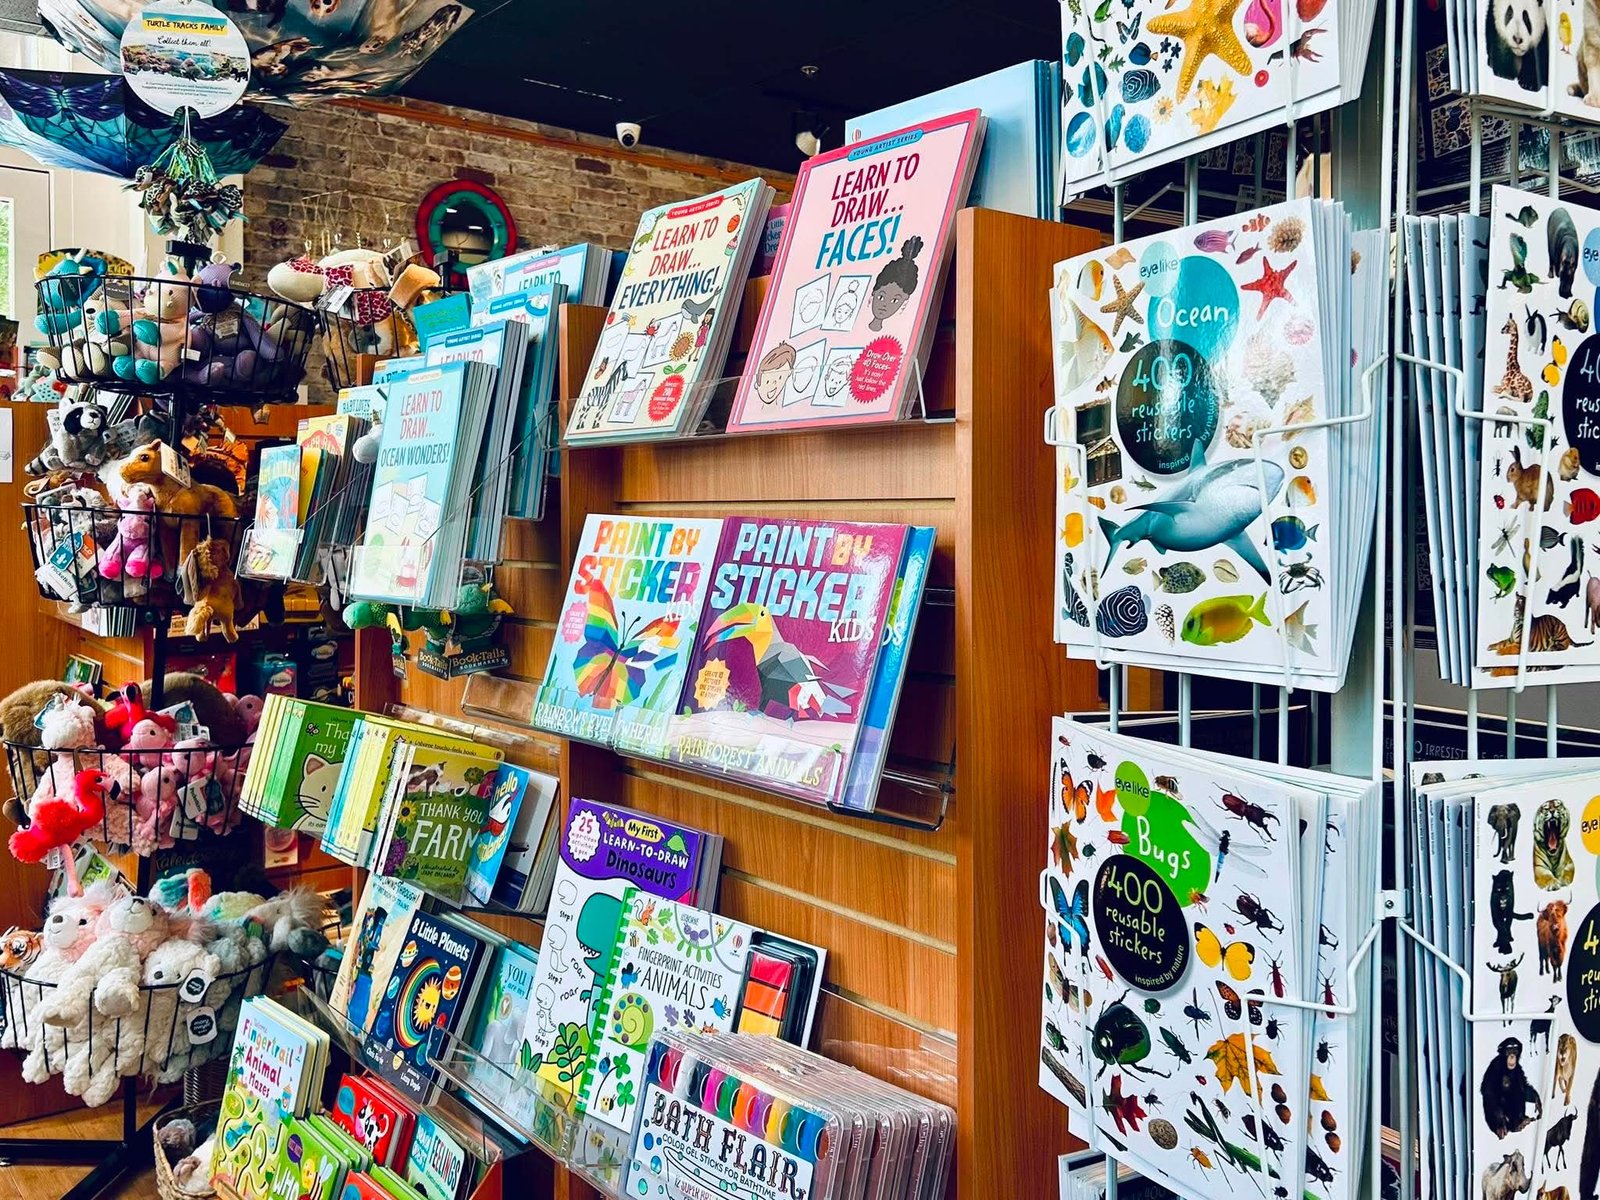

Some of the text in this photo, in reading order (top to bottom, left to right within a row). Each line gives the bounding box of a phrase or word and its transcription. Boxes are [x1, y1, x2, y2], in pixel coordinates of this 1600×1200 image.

[146, 20, 225, 32] TURTLE TRACKS FAMILY
[158, 36, 180, 46] Collect
[181, 38, 198, 46] them
[853, 133, 918, 158] YOUNG ARTIST SERIES
[831, 152, 920, 201] LEARN TO
[831, 190, 904, 228] DRAW...
[652, 216, 720, 252] LEARN TO
[816, 214, 902, 270] FACES!
[648, 248, 701, 277] DRAW...
[618, 266, 721, 310] EVERYTHING!
[1157, 298, 1229, 328] Ocean
[472, 349, 484, 361] TO
[866, 350, 896, 362] Draw Over
[1132, 352, 1192, 392] 400
[400, 392, 430, 416] LEARN
[432, 390, 442, 412] TO
[1132, 391, 1195, 418] reusle
[1576, 396, 1600, 414] reus
[400, 416, 434, 440] DRAW...
[1136, 422, 1192, 442] stickers
[1200, 429, 1210, 441] by
[1577, 416, 1600, 440] stic
[380, 442, 450, 468] OCEAN WONDERS!
[1158, 454, 1190, 470] inspired
[593, 520, 700, 558] PAINT BY
[732, 524, 874, 568] PAINT BY
[574, 555, 702, 604] STICKER
[710, 562, 875, 622] STICKER
[664, 601, 700, 622] KIDS
[828, 618, 876, 643] KIDS
[536, 702, 588, 726] RAINBOWS
[326, 722, 349, 740] Tha
[316, 742, 336, 758] my
[414, 740, 434, 748] Usborne
[464, 748, 477, 756] books
[677, 735, 824, 786] RAINFOREST ANIMLS
[420, 802, 462, 819] THANK
[579, 816, 594, 834] 25
[628, 822, 659, 840] My First
[603, 832, 689, 870] LEARN-TO-DRAW
[1136, 815, 1192, 880] Bugs
[606, 850, 678, 890] Dinosaurs
[1108, 866, 1162, 914] 400
[560, 910, 570, 922] Step
[1106, 906, 1165, 942] reusable
[412, 918, 471, 962] 8 Little Planets
[1109, 929, 1162, 965] stickers
[504, 964, 527, 986] you
[548, 972, 558, 984] Step
[570, 957, 586, 980] roar
[638, 946, 723, 988] FINGERPRINT ACTIVITIES
[1135, 944, 1184, 986] inspired by nature
[560, 986, 580, 1002] roar
[641, 967, 709, 1010] ANIMALS
[243, 1018, 294, 1068] Fingertrail
[535, 1034, 545, 1048] Step
[246, 1046, 282, 1086] Animal
[249, 1071, 270, 1098] Mazes
[651, 1091, 806, 1200] BATH FLAIR
[429, 1135, 460, 1192] FEELINGS
[662, 1134, 776, 1199] COLOR GEL STICKS FOR BATHTIME
